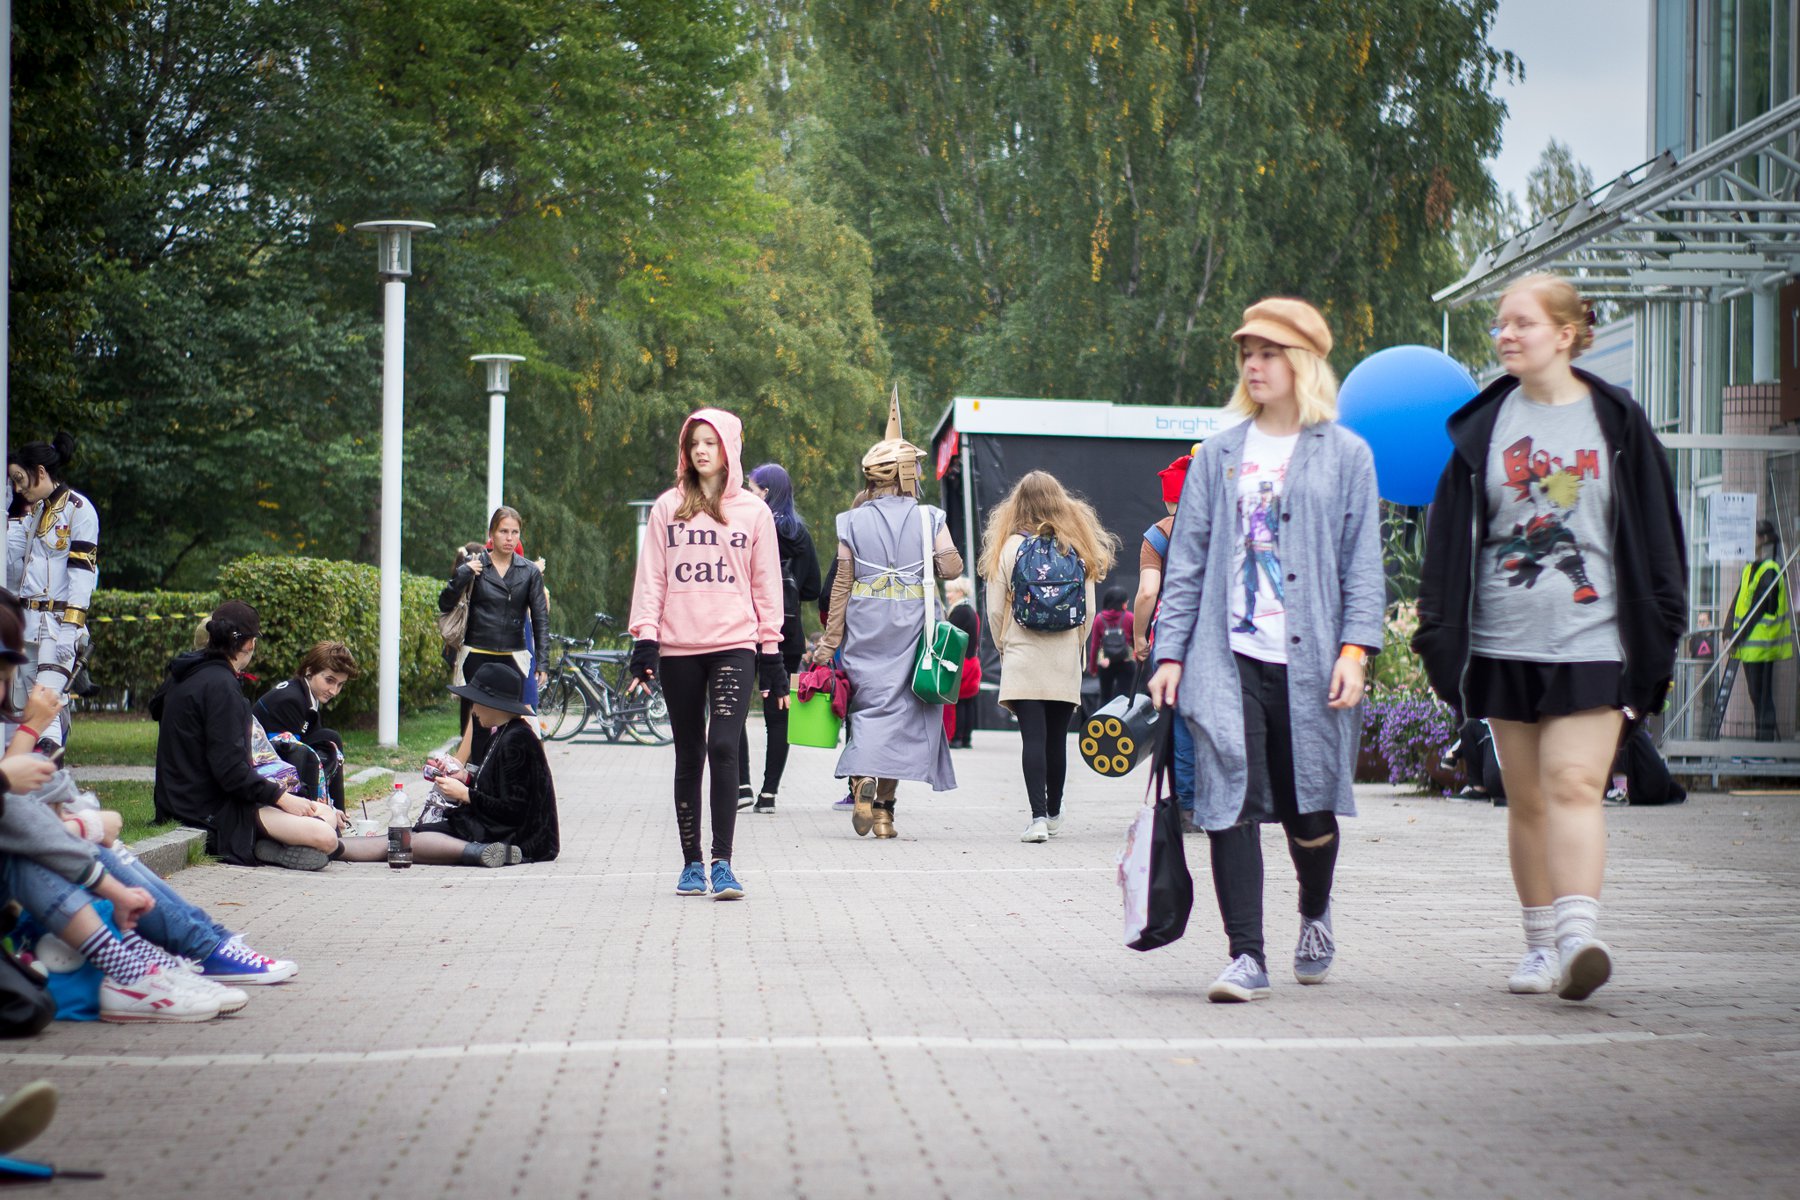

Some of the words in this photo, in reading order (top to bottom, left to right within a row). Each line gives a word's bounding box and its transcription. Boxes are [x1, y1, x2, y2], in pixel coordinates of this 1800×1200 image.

[1156, 416, 1219, 434] bright
[667, 522, 719, 548] I'm
[730, 531, 747, 549] a
[675, 556, 735, 583] cat.
